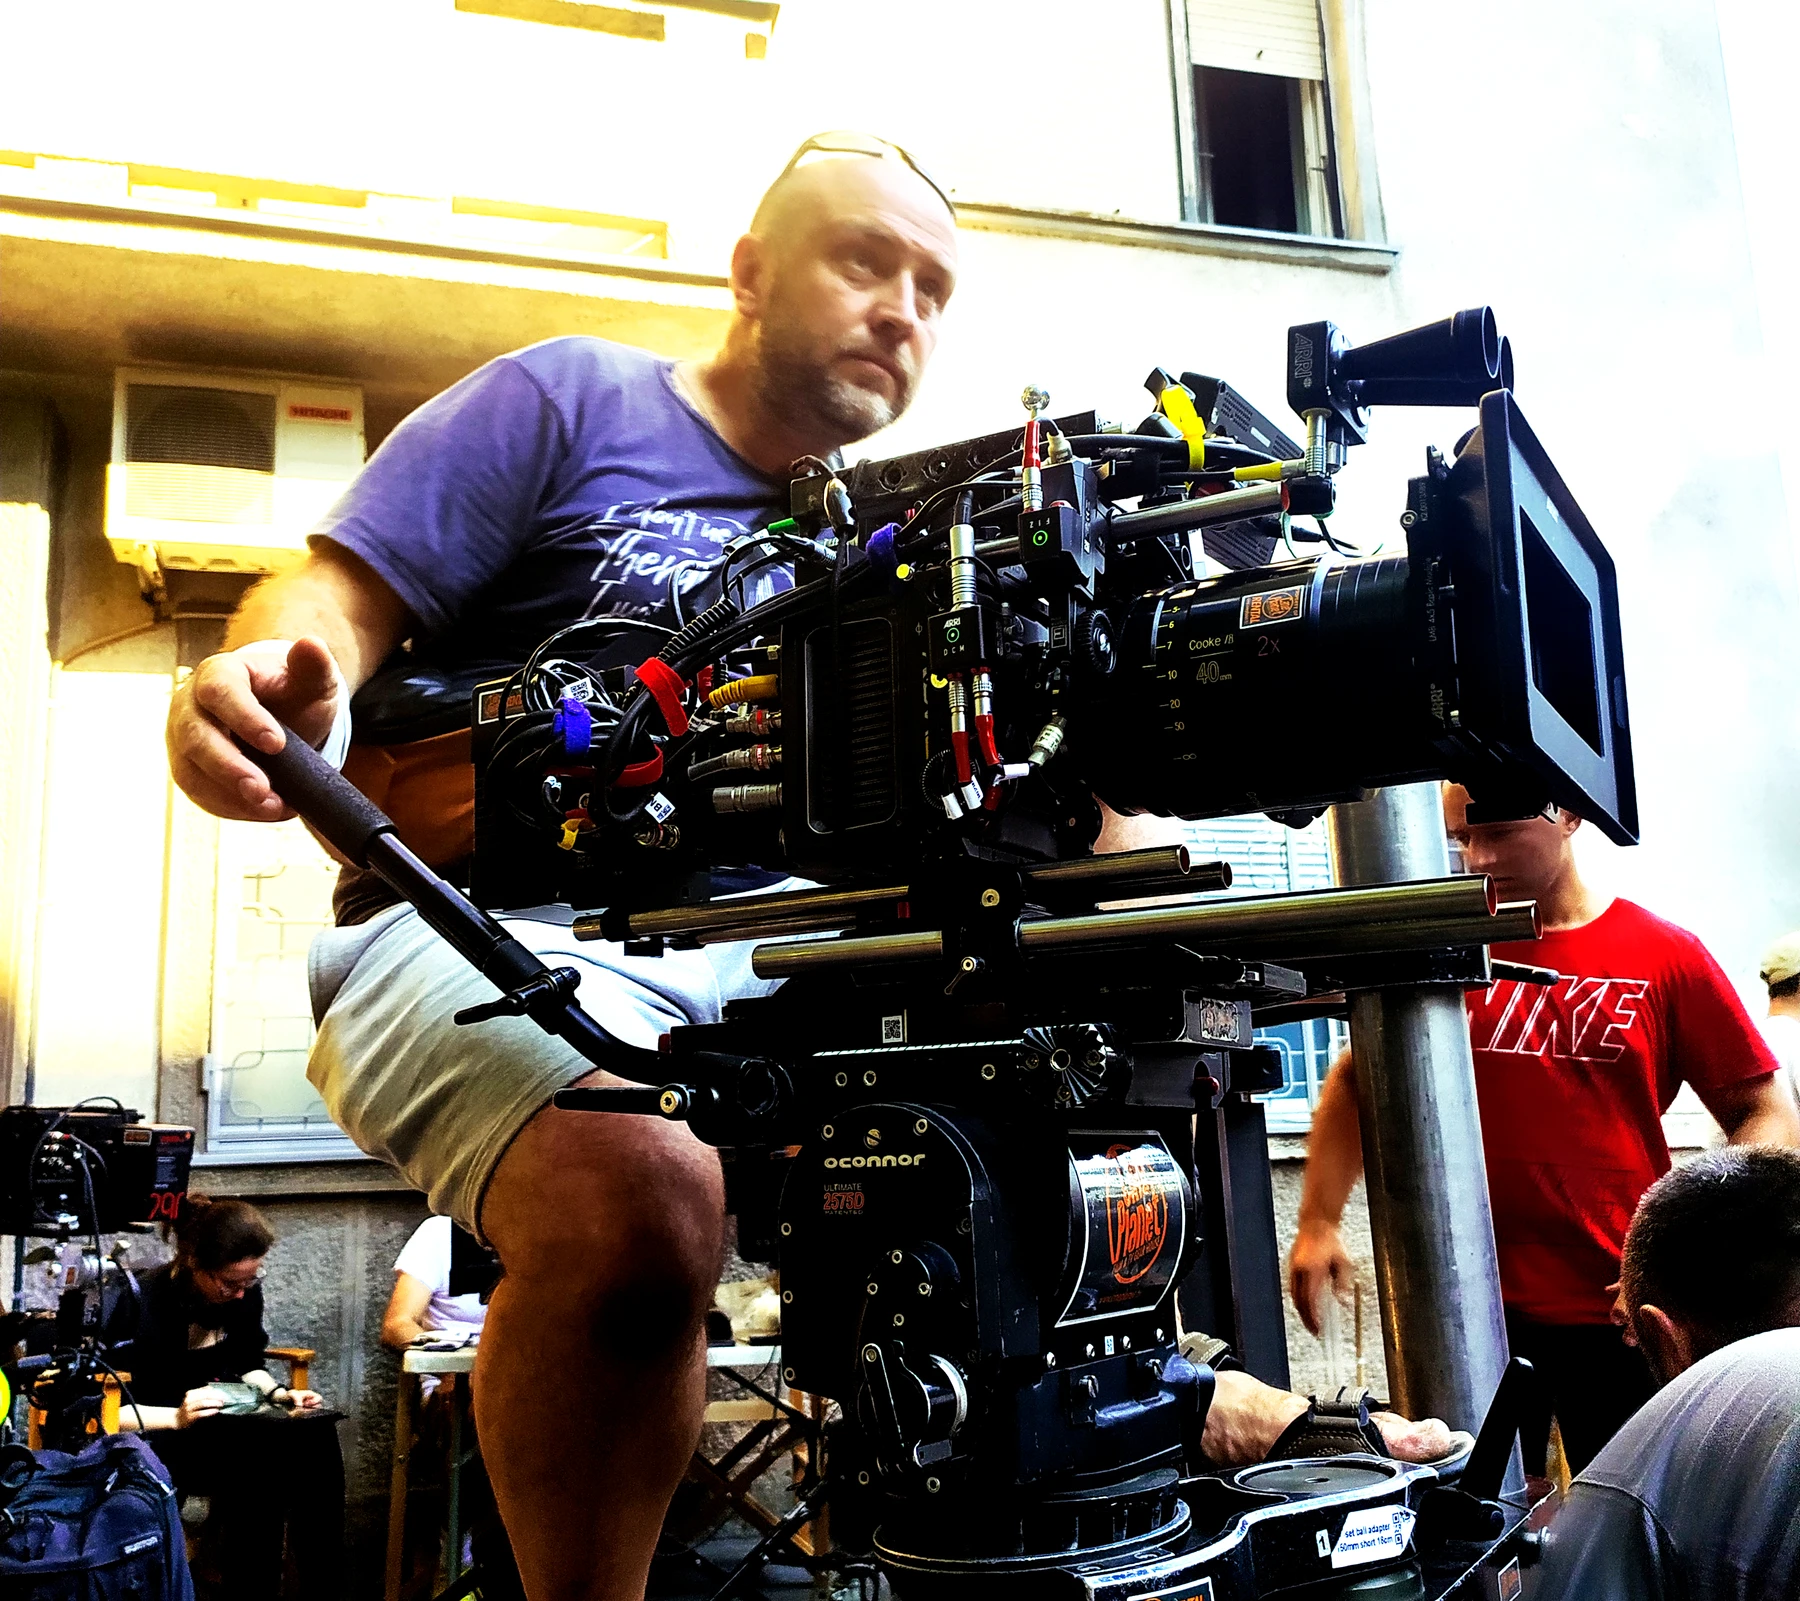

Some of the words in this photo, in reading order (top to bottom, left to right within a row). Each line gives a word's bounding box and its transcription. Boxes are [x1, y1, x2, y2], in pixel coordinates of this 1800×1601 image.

[1294, 333, 1313, 379] ARRI
[944, 617, 961, 629] ARRI
[1188, 636, 1222, 651] Cooke
[1257, 635, 1281, 657] 2x
[1167, 670, 1178, 680] 10
[1169, 698, 1181, 709] 20
[1174, 721, 1185, 731] 50
[823, 1153, 926, 1169] oconnor
[823, 1182, 863, 1192] ULTIMATE
[823, 1191, 865, 1211] 2575D
[1116, 1192, 1161, 1257] Planet
[1345, 1529, 1355, 1538] set
[1356, 1525, 1367, 1536] ball
[1368, 1523, 1390, 1534] adapter
[1319, 1536, 1326, 1550] 1
[1360, 1539, 1375, 1548] short
